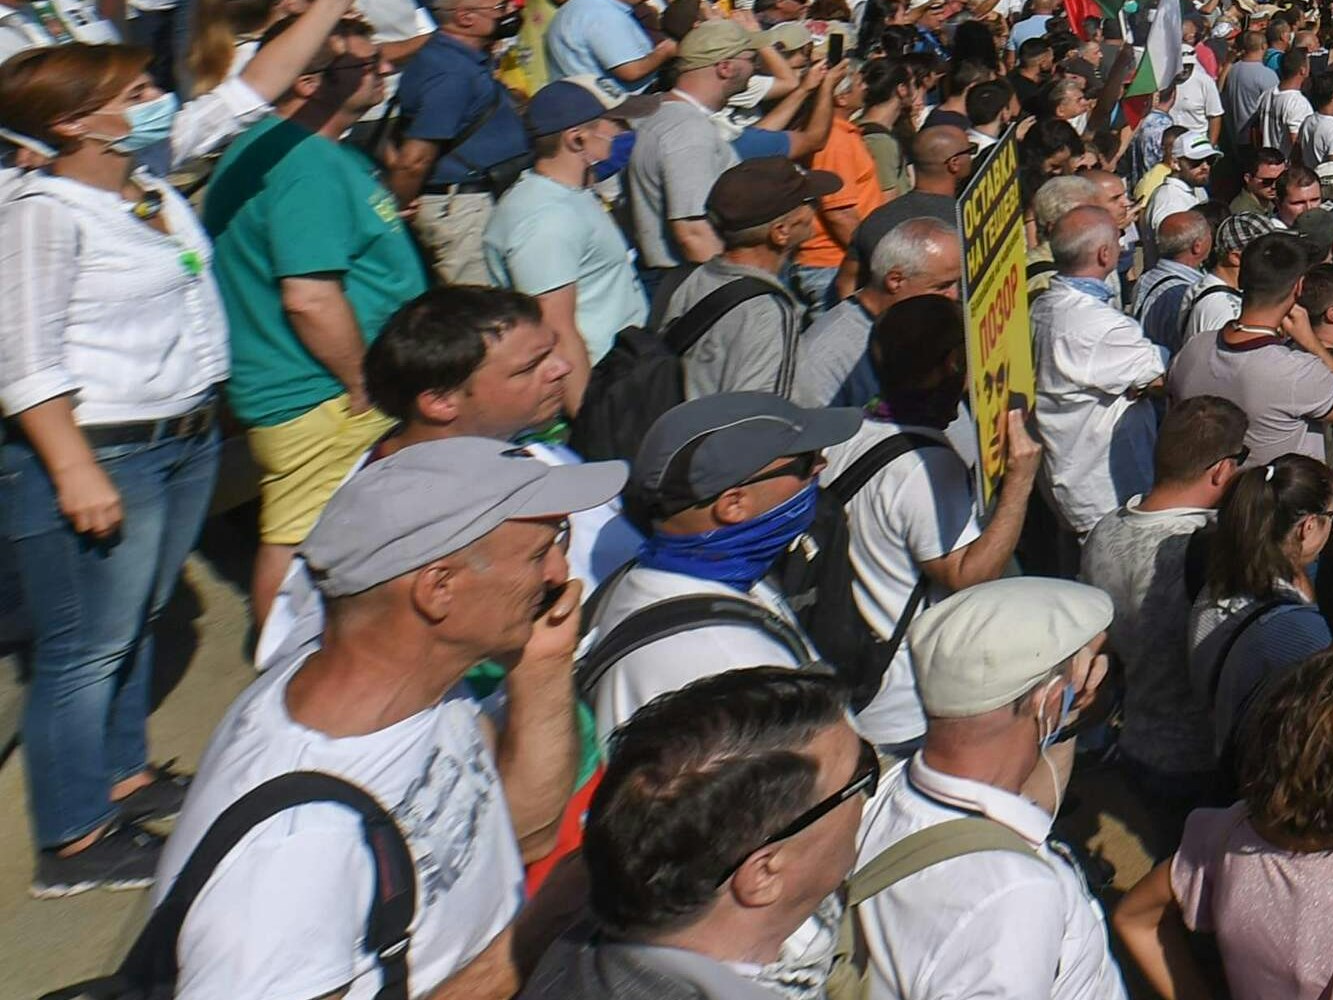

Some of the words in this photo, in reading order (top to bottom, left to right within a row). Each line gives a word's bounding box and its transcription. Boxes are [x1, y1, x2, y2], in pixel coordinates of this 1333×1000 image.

[963, 139, 1017, 239] ОСТАВКА
[967, 237, 984, 284] НА
[978, 263, 1018, 368] ПОЗОР
